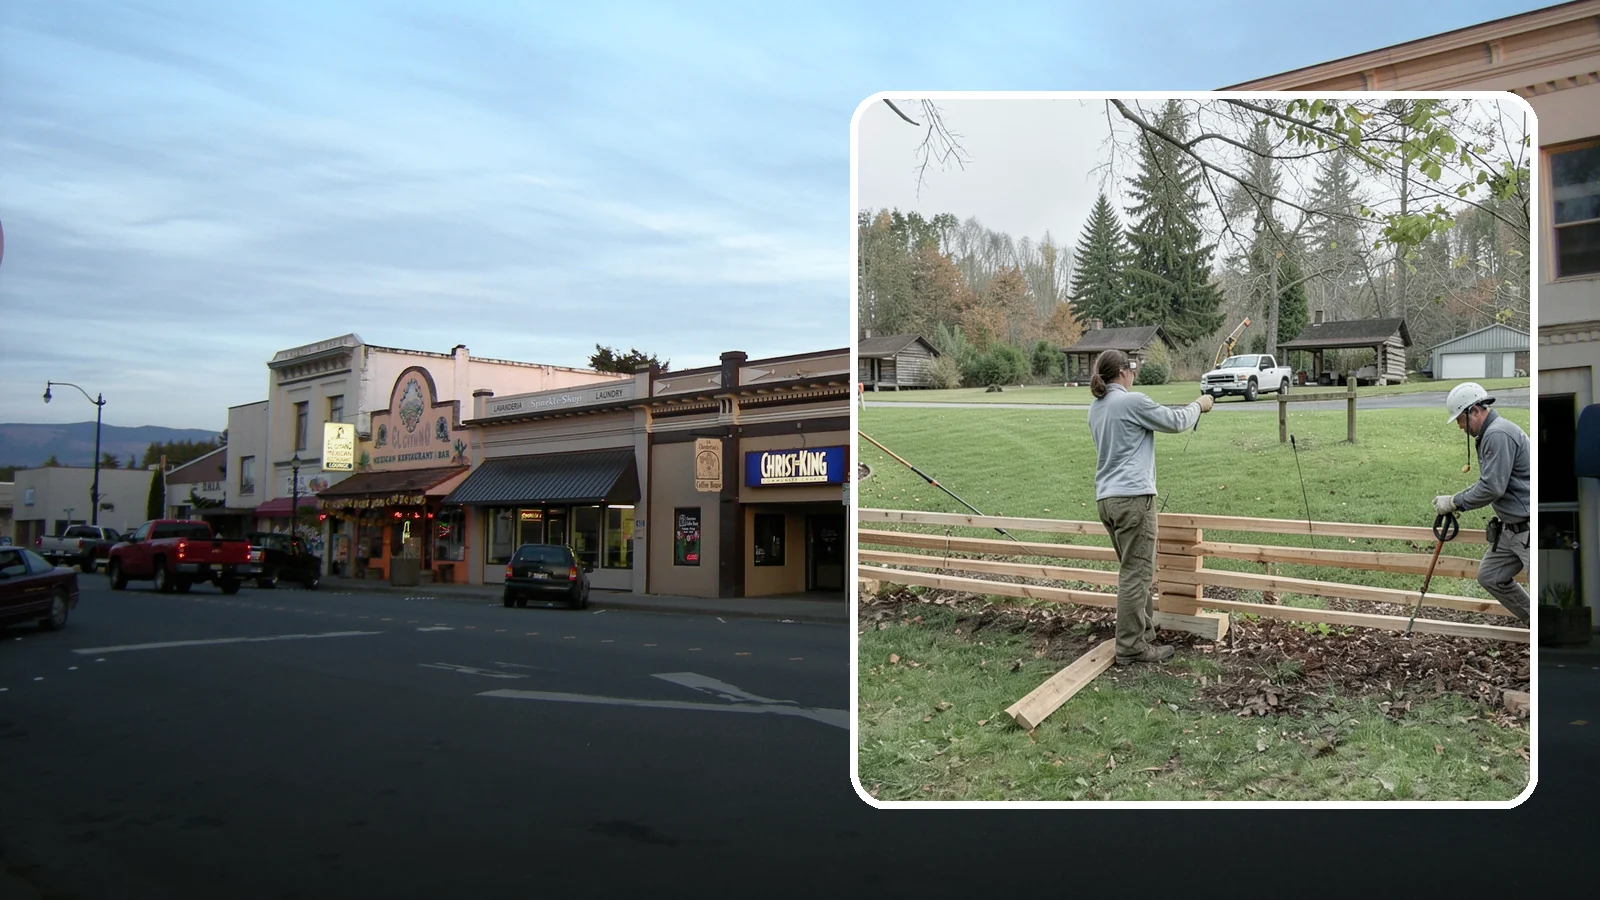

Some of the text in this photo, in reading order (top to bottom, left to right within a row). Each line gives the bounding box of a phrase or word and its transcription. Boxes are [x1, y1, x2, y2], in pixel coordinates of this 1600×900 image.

[494, 402, 522, 412] LAVANDERIA
[595, 389, 623, 399] LAUNDRY
[398, 451, 433, 462] RESTAURANT
[438, 450, 450, 458] BAR
[761, 450, 827, 477] CHRIST KING
